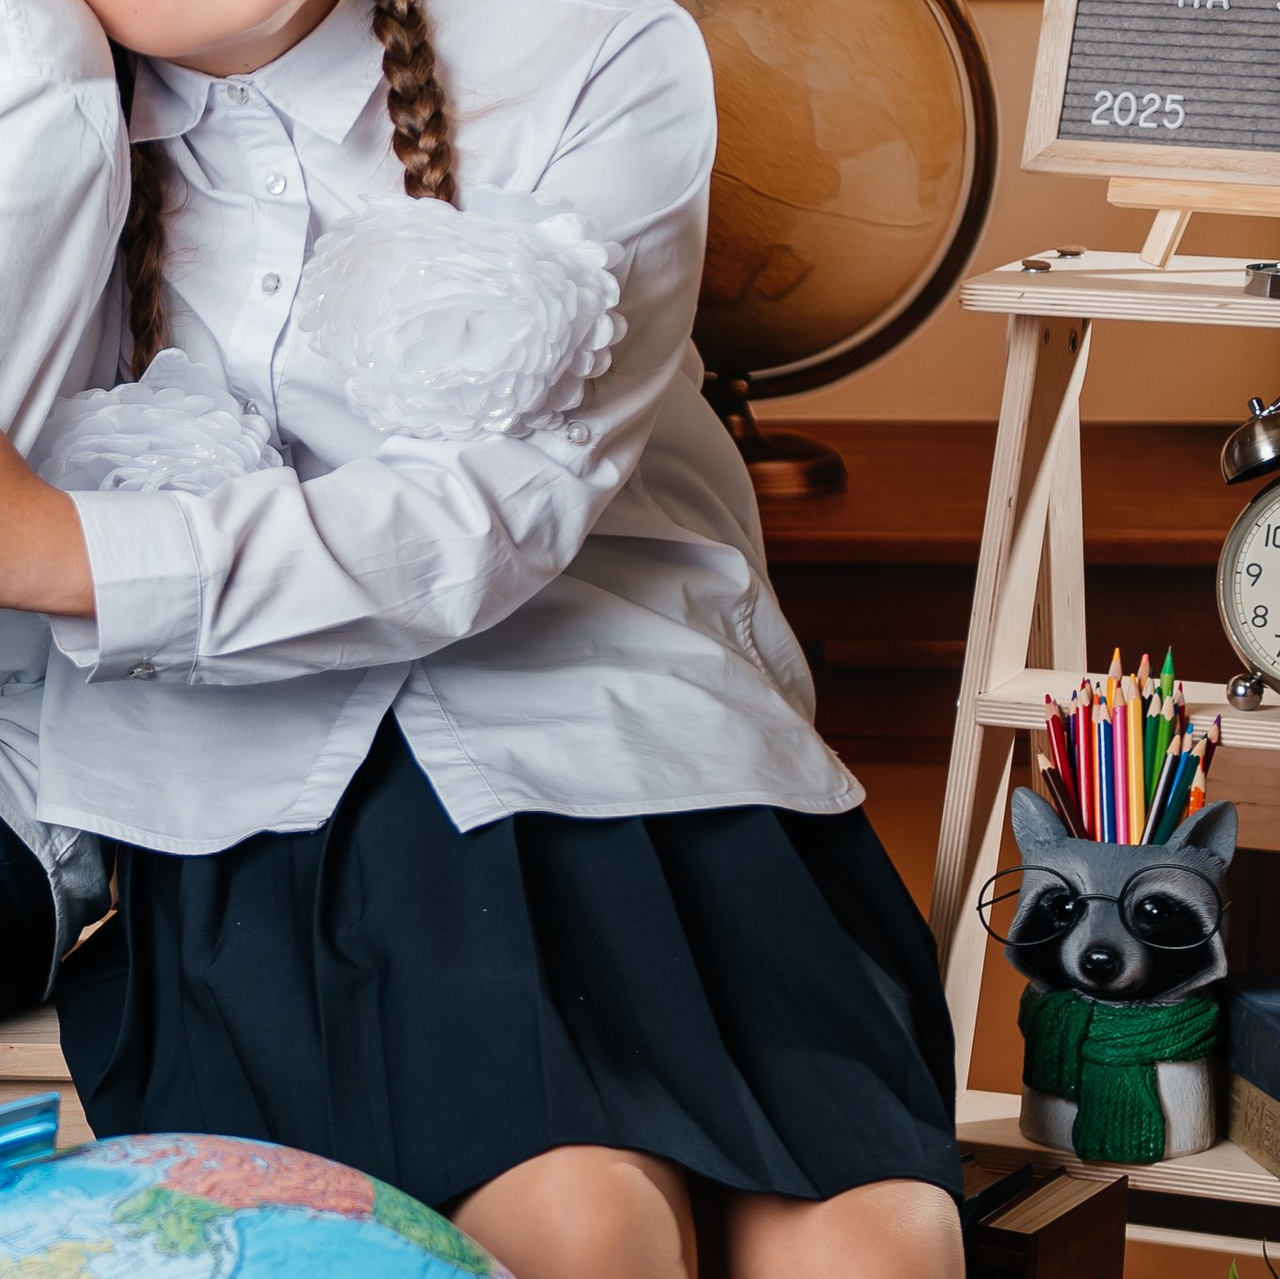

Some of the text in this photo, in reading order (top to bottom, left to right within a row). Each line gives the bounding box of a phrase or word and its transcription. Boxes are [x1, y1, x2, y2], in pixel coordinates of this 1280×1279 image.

[1091, 90, 1186, 130] 2025
[1246, 562, 1263, 588] 9
[1251, 604, 1269, 628] 8
